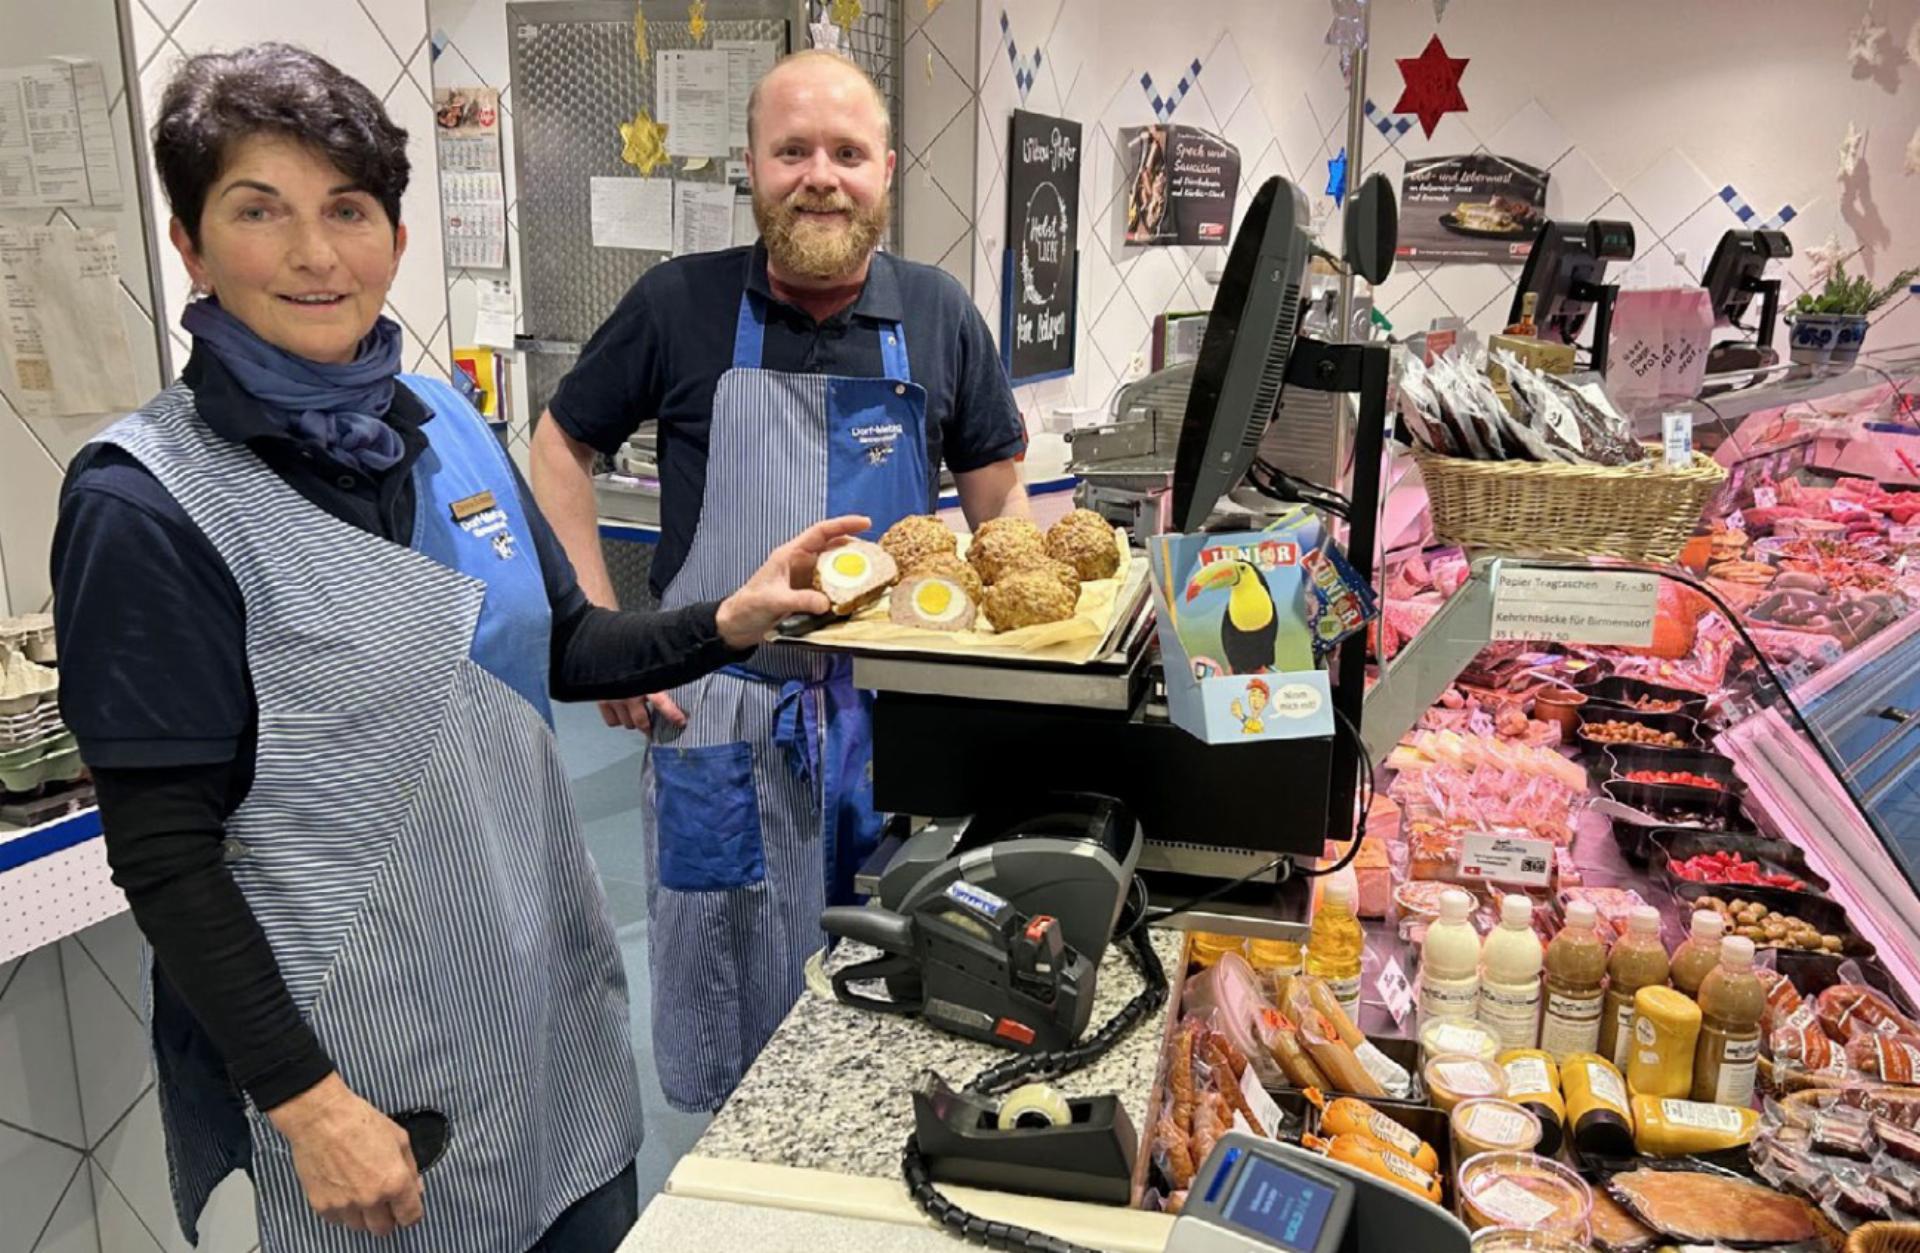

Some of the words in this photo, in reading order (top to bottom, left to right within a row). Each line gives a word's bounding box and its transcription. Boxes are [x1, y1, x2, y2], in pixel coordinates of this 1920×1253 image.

[1176, 143, 1204, 158] Speck
[1207, 148, 1228, 158] und
[1173, 159, 1221, 174] Saucisson
[1439, 172, 1458, 182] und
[1635, 353, 1660, 377] brot
[1499, 575, 1532, 588] Papier
[1535, 577, 1599, 590] Tragtaschen
[1495, 612, 1567, 626] Kehrichtsäcke
[1569, 615, 1585, 626] für
[1587, 616, 1651, 629] Birmenstorf
